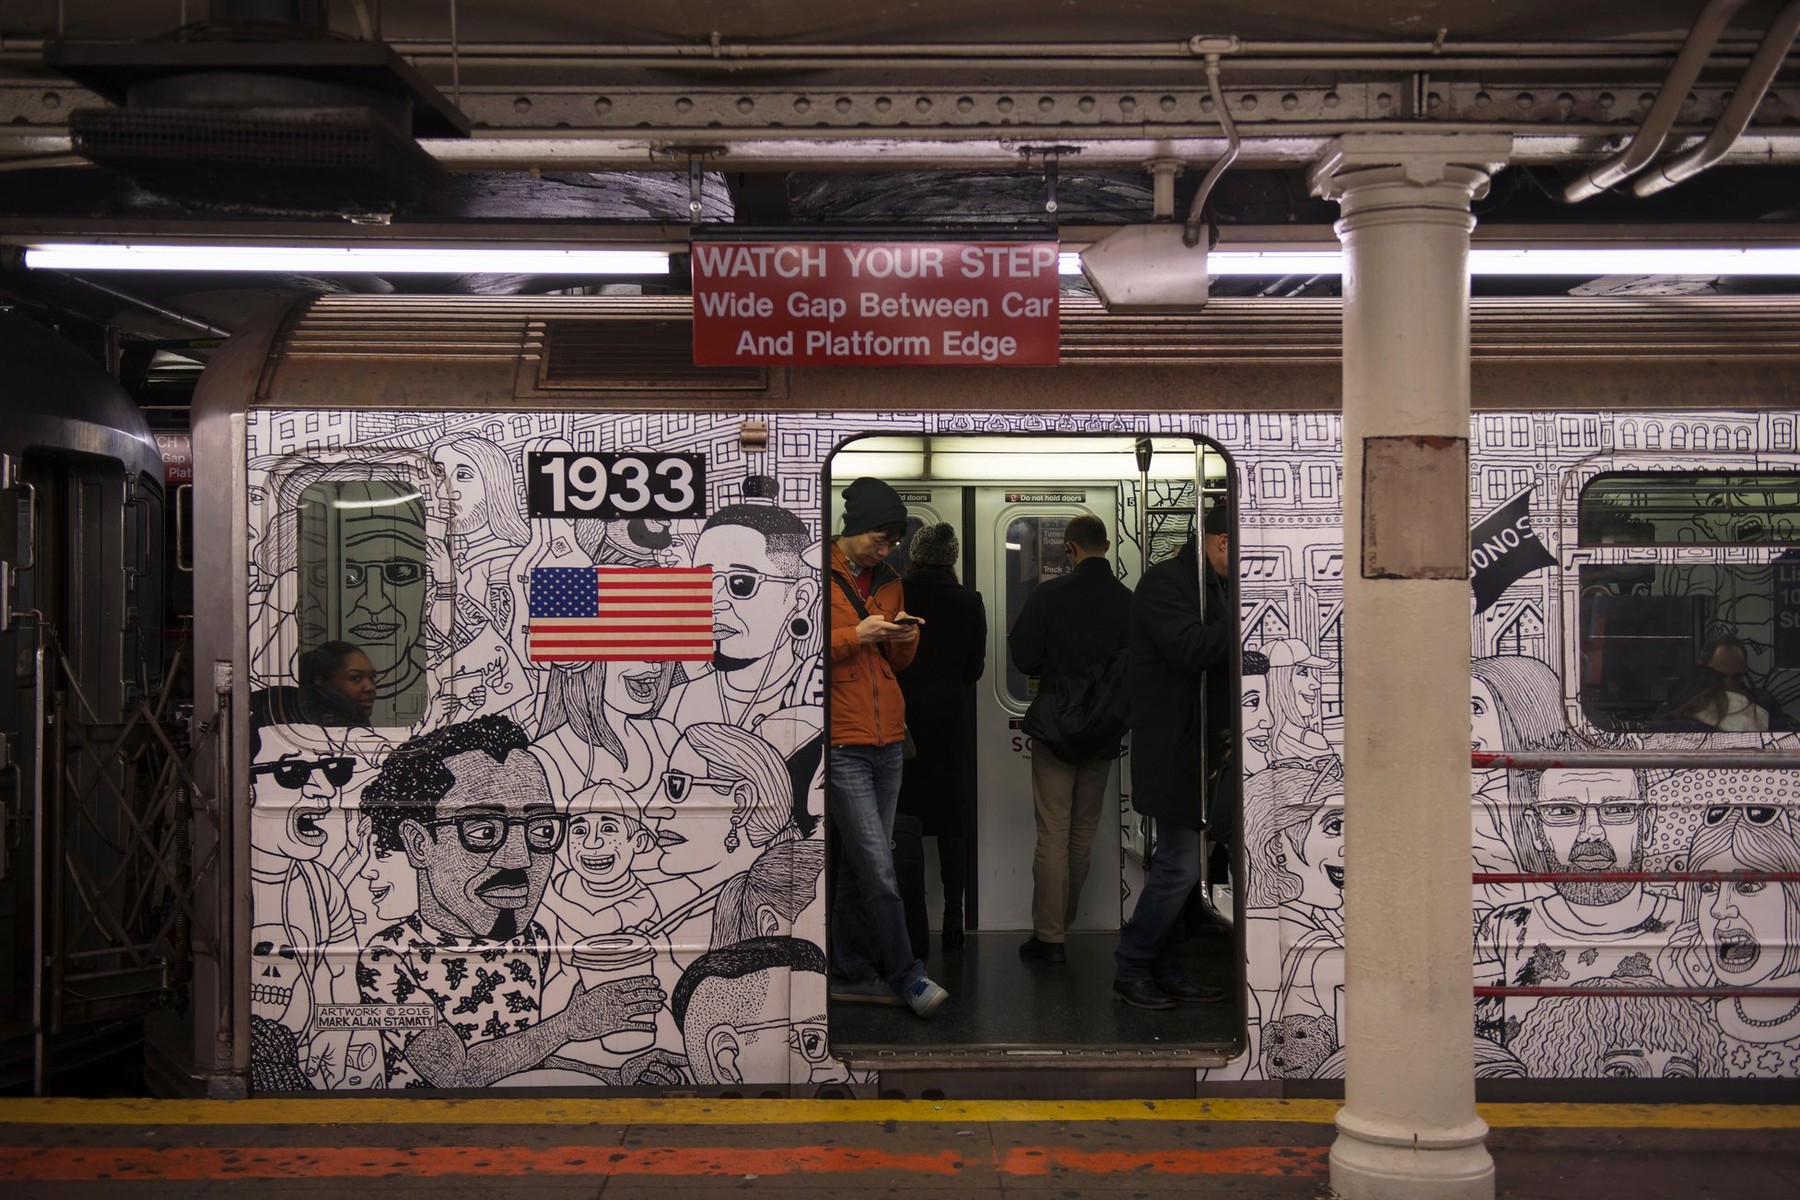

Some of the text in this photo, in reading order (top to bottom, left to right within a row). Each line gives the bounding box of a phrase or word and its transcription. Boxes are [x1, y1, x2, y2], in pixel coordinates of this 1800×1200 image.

[698, 246, 1056, 279] WATCH YOUR STEP
[699, 291, 1053, 323] Wide Gap Between Car
[735, 330, 1017, 361] And Platform Edge
[157, 436, 178, 448] CH
[161, 453, 186, 465] Gap
[169, 467, 192, 478] Plat
[541, 456, 695, 512] 1933
[1470, 515, 1535, 578] ONOS
[1043, 565, 1063, 574] Track
[319, 1007, 382, 1016] ARTWORK:
[398, 1007, 431, 1016] 2016
[318, 1016, 434, 1027] MARK ALAN STAMATY
